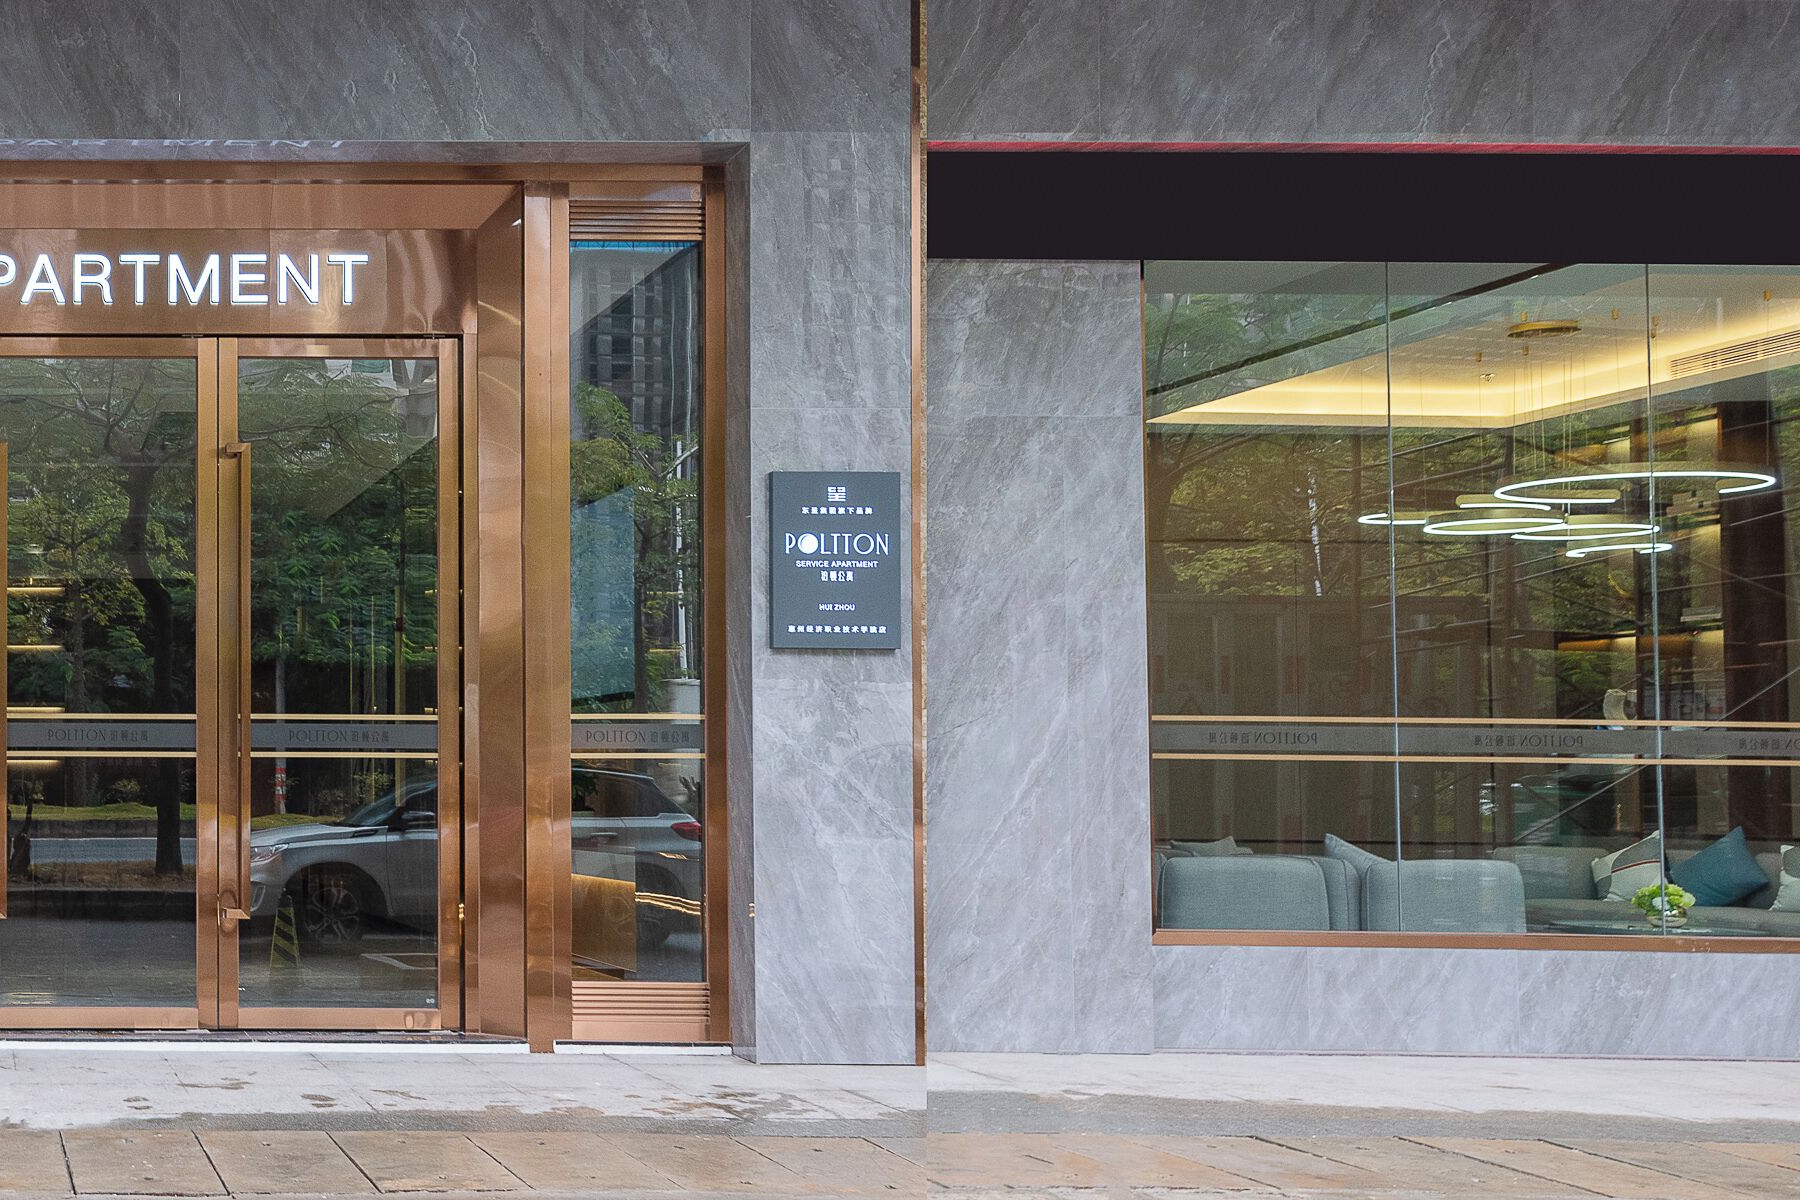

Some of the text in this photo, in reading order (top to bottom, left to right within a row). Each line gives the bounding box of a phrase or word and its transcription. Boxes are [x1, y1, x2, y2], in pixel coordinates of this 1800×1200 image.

[785, 532, 889, 556] POLTTON
[795, 560, 879, 568] SERVICE APARTMENT
